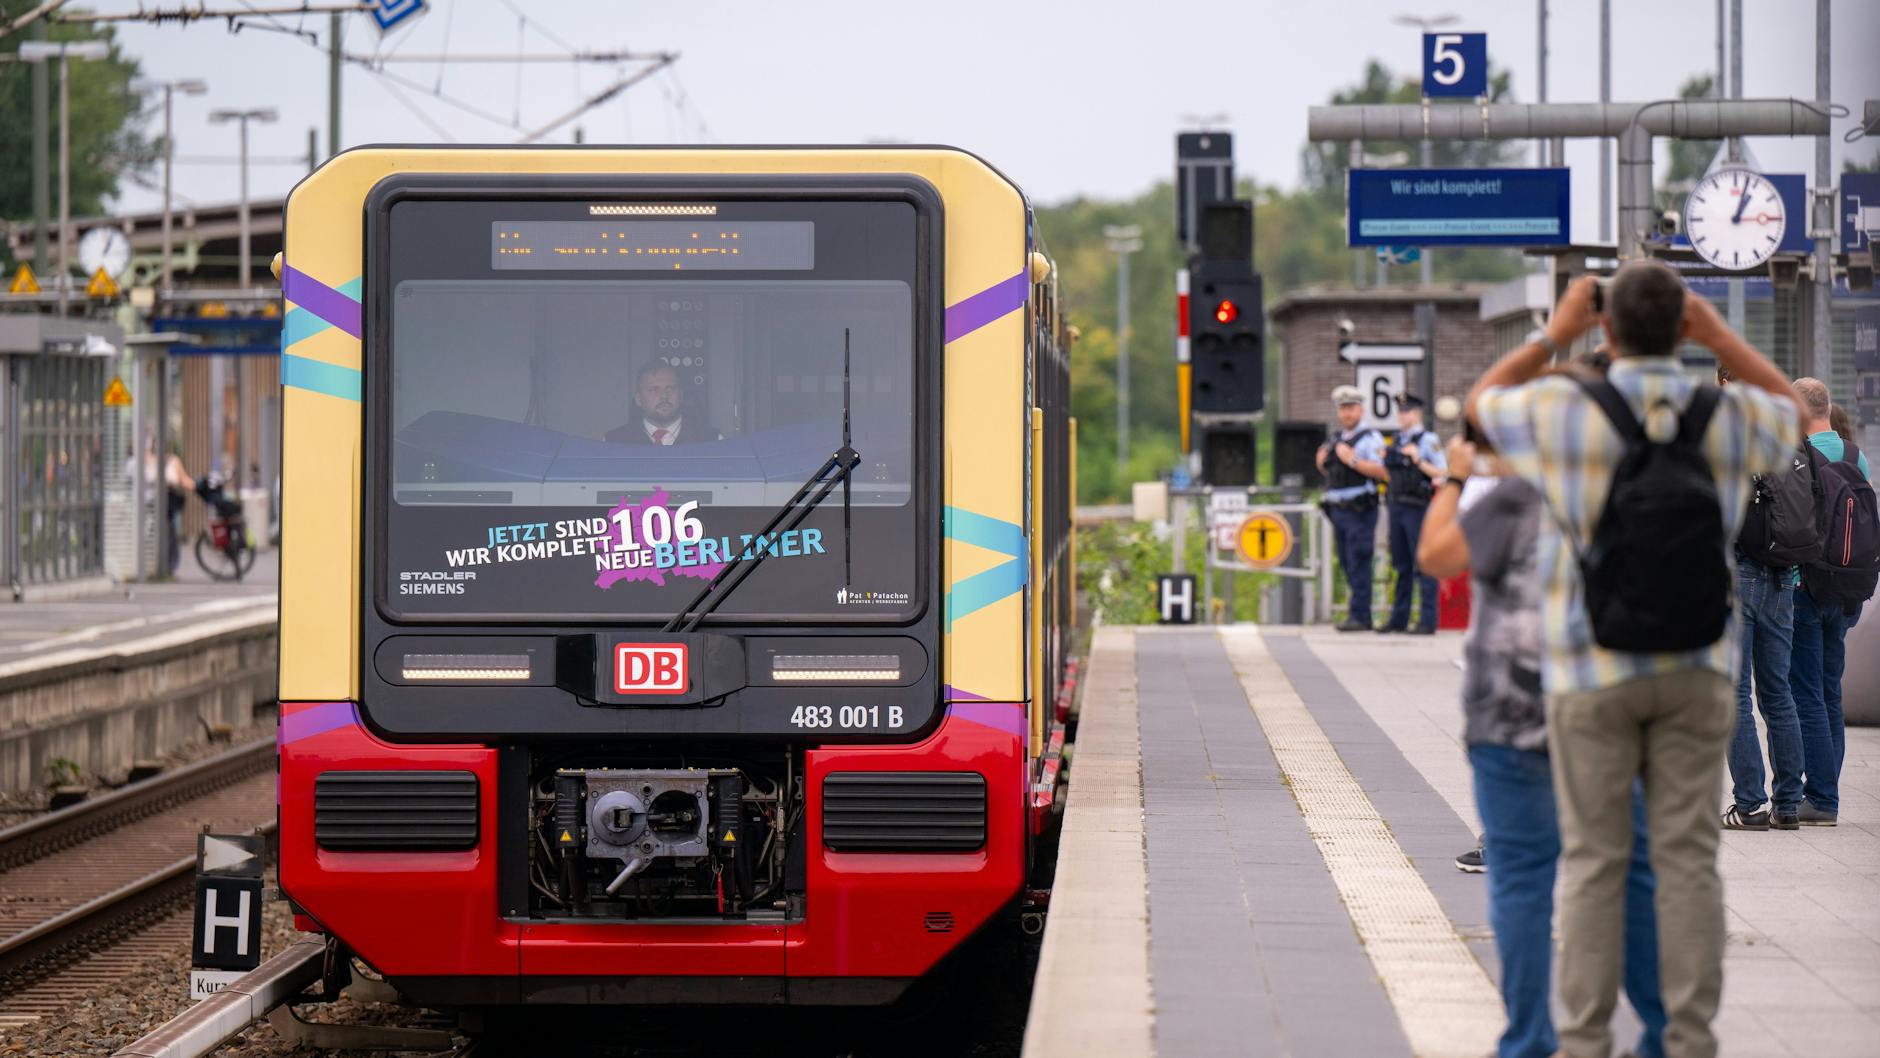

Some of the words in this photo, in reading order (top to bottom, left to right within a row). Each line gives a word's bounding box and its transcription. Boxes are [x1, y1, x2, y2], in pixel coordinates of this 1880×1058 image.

[1432, 35, 1465, 85] 5
[1391, 180, 1412, 195] Wir
[1414, 179, 1440, 195] sind
[1441, 179, 1501, 197] komplett!
[1373, 376, 1391, 419] 6
[488, 522, 549, 549] JETZT
[555, 517, 608, 539] SIND
[612, 500, 704, 552] 106
[446, 547, 491, 567] WIR
[497, 536, 612, 563] KOMPLETT
[595, 550, 653, 571] NEUE
[655, 528, 826, 569] BERLINER
[400, 571, 477, 580] STADLER
[400, 583, 465, 595] SIEMENS
[1161, 579, 1192, 621] H
[624, 651, 679, 685] DB
[790, 705, 833, 728] 483
[839, 705, 879, 728] 001
[888, 706, 904, 728] B
[203, 888, 251, 956] H
